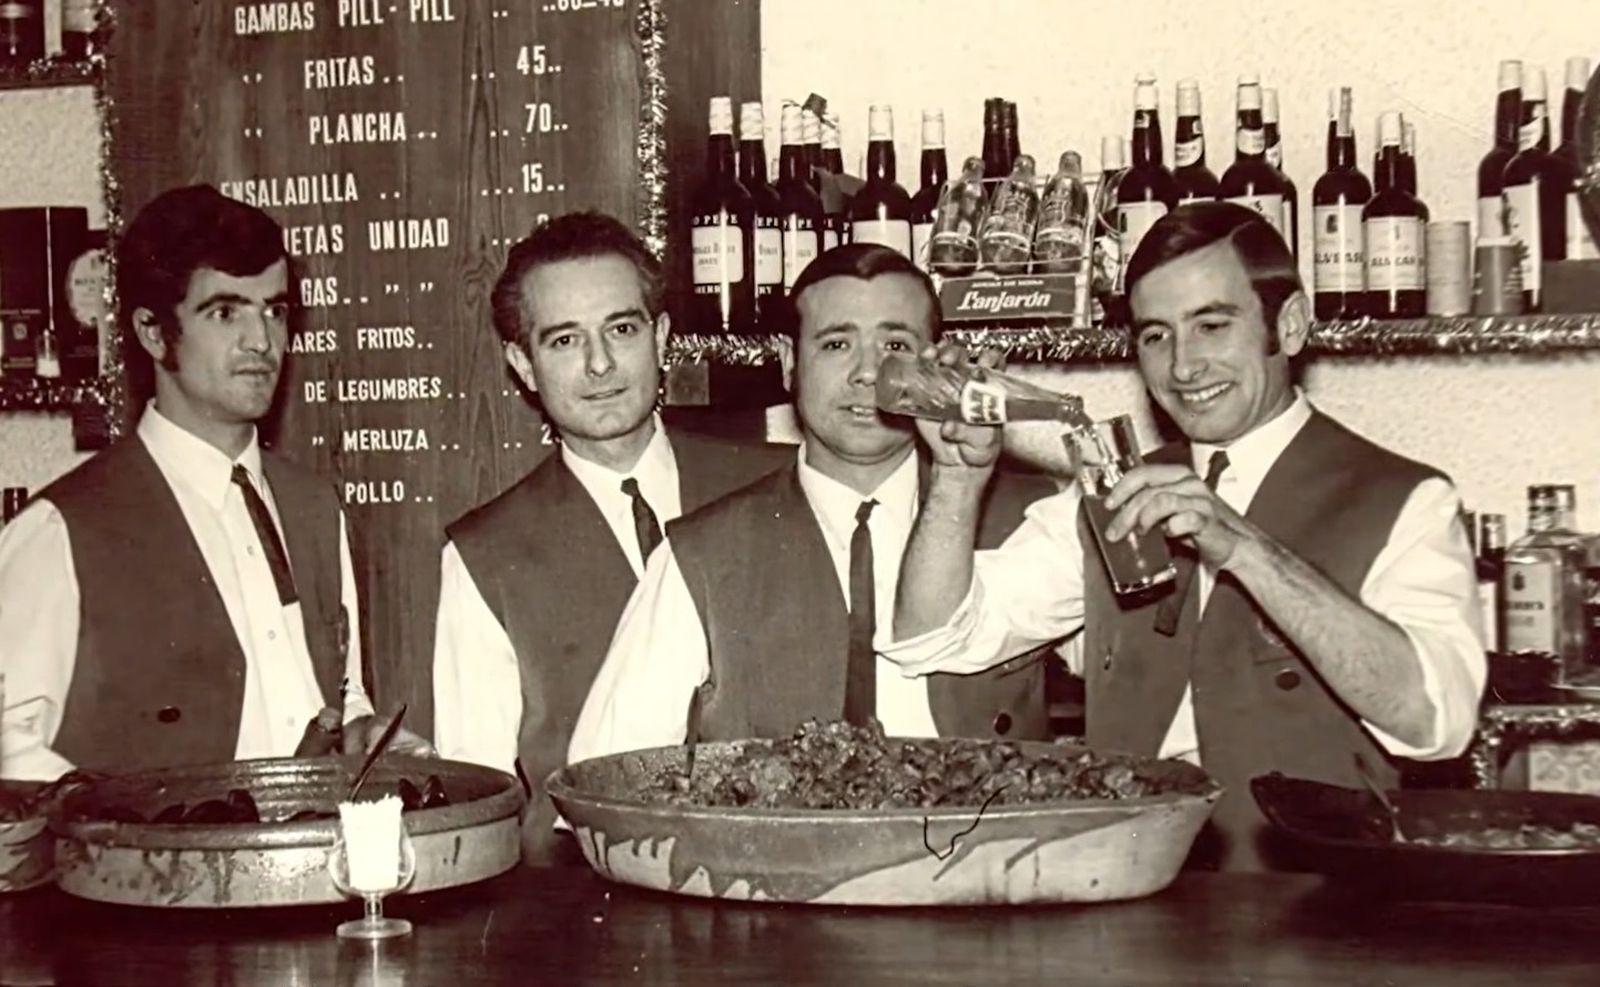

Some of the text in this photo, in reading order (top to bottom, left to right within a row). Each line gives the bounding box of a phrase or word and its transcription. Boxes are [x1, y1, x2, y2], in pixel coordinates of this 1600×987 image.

[234, 1, 314, 35] GAMBAS
[368, 217, 449, 251] UNIDAD
[957, 291, 1051, 313] Lanjarón
[288, 329, 337, 353] ARES
[304, 381, 327, 403] DE
